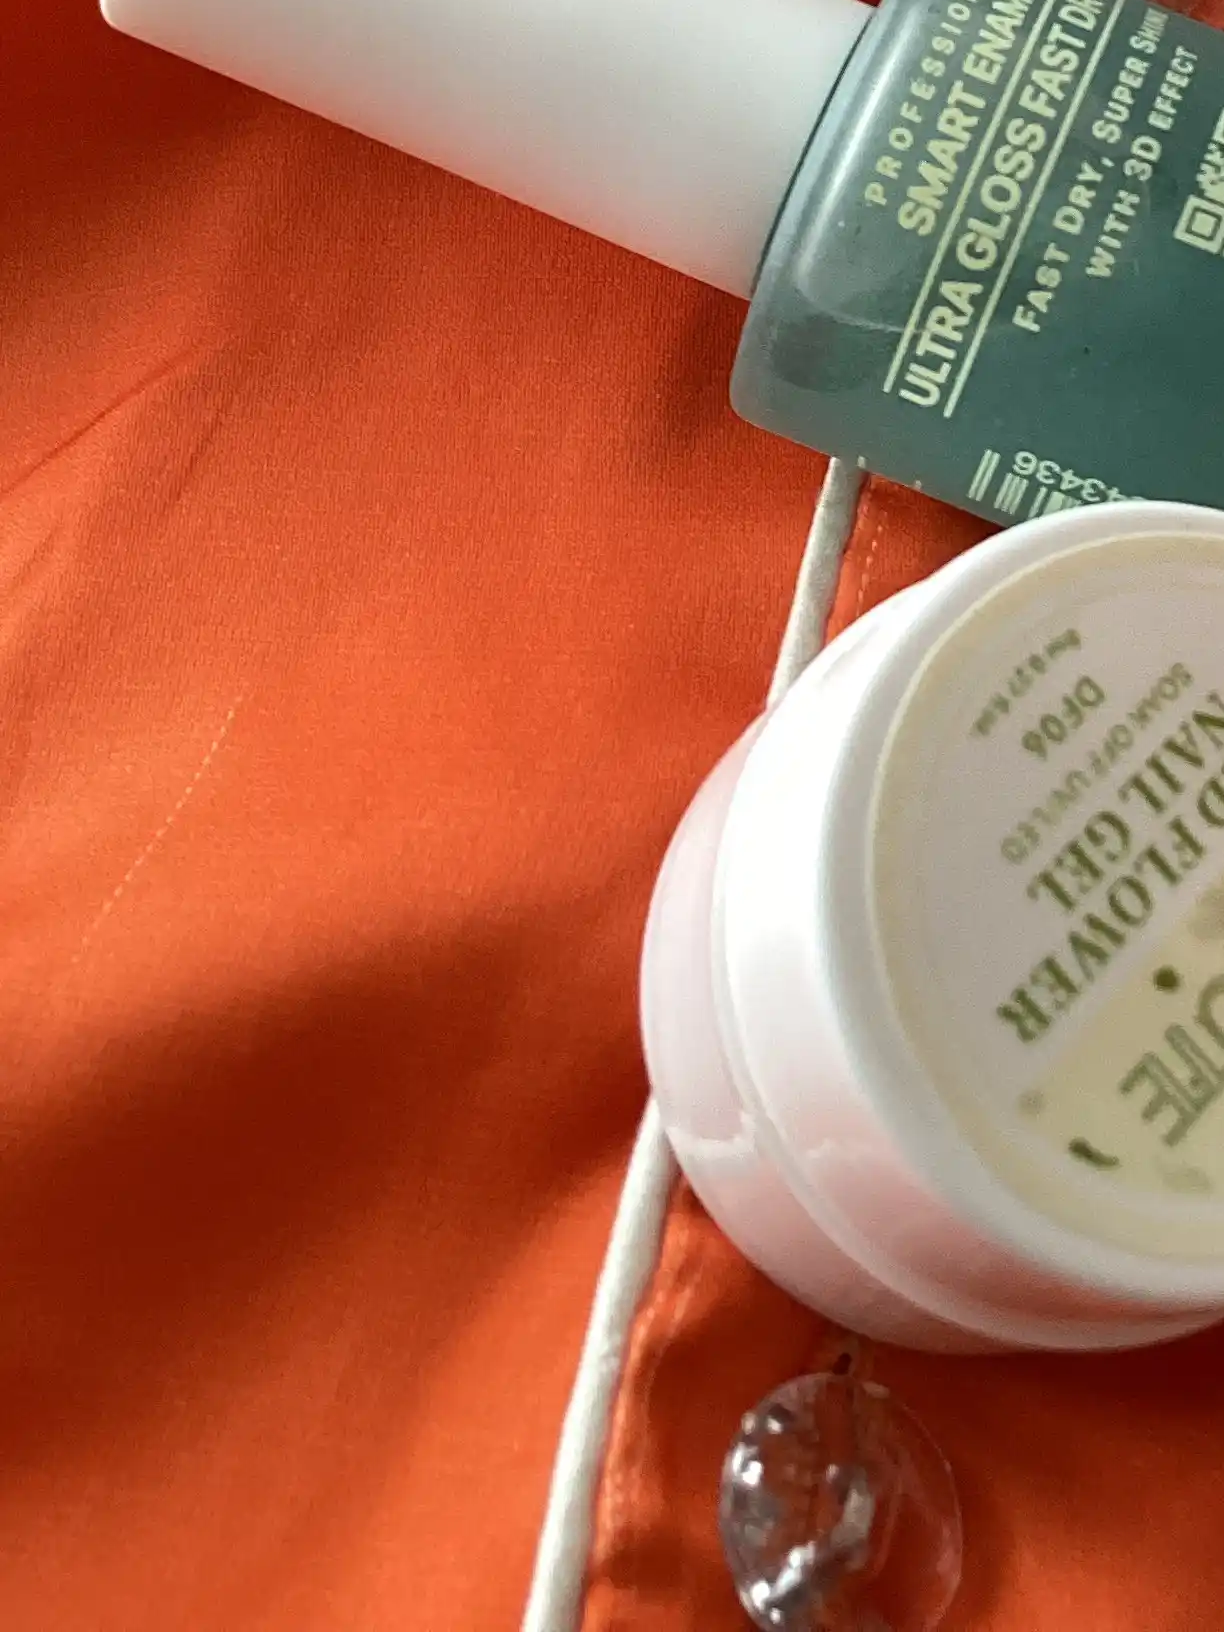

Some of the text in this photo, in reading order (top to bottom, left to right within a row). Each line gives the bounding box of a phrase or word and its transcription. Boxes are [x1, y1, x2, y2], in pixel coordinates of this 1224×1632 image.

[898, 80, 986, 237] SMART
[899, 280, 984, 407] ULTRA
[956, 118, 1047, 271] GLOSS
[1018, 23, 1087, 119] FAST
[1085, 45, 1198, 277] WITH 3D EFFECT
[1021, 675, 1105, 761] DF06
[997, 814, 1207, 1044] FLOWER
[1026, 810, 1135, 915] GEL
